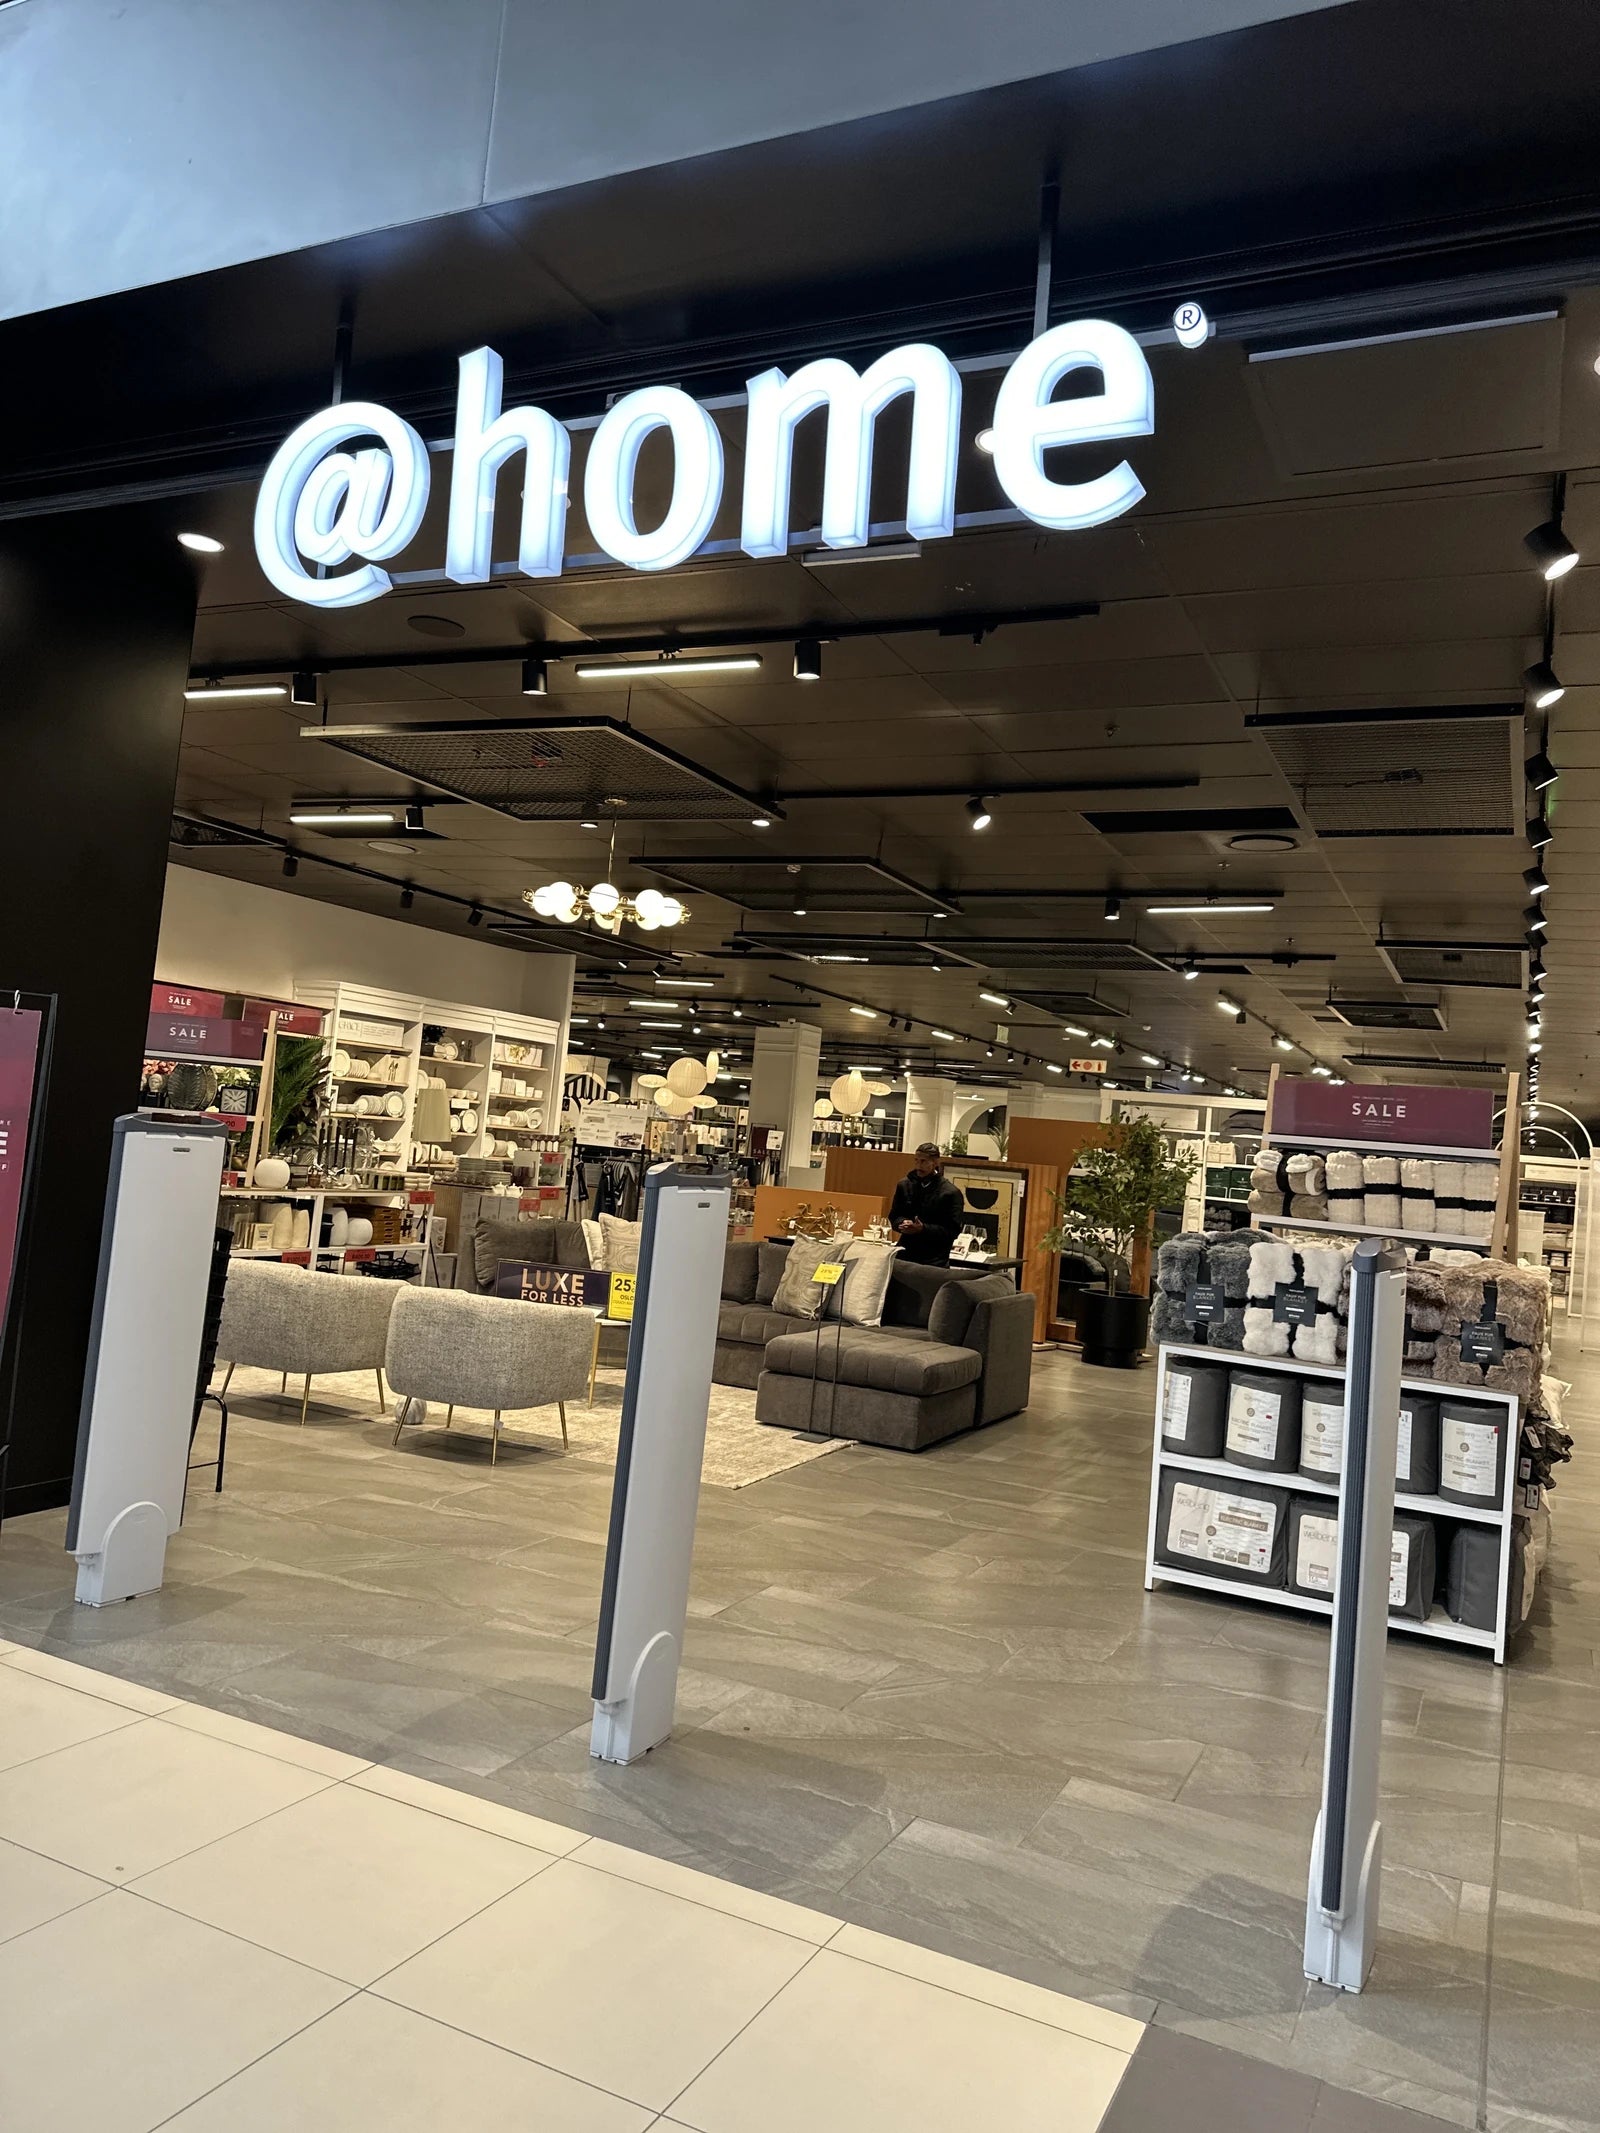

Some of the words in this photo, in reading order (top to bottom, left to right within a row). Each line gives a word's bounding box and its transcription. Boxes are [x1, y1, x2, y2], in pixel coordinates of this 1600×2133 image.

[254, 318, 1156, 608] @home
[168, 995, 192, 1006] SALE
[278, 1012, 294, 1021] ALE
[169, 1026, 207, 1039] SALE
[1352, 1102, 1406, 1118] SALE
[521, 1268, 585, 1295] LUXE
[520, 1289, 548, 1303] FOR
[552, 1293, 585, 1307] LESS
